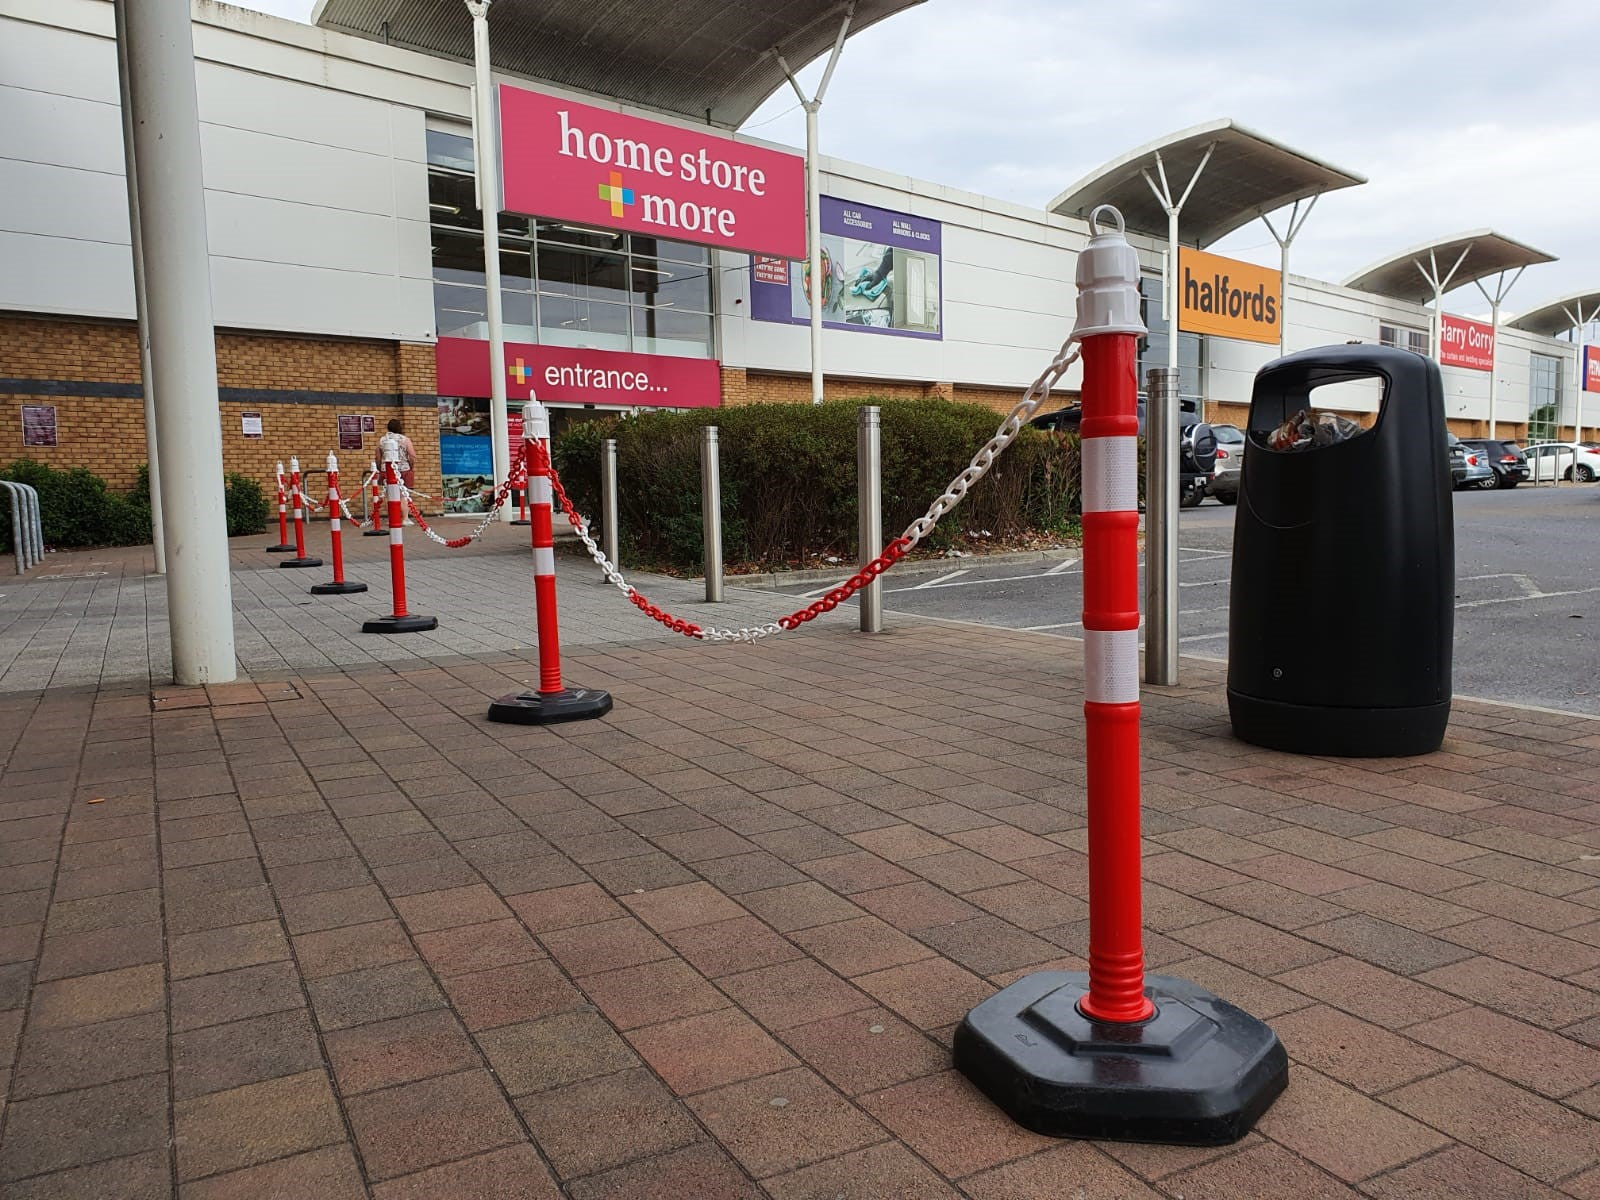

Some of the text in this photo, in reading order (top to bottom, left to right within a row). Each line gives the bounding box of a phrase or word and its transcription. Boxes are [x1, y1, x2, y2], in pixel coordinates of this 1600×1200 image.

[556, 111, 766, 196] home store
[641, 194, 736, 237] more
[1184, 267, 1276, 324] halfords
[1440, 319, 1494, 355] Harry Corry
[544, 363, 668, 392] entrance...
